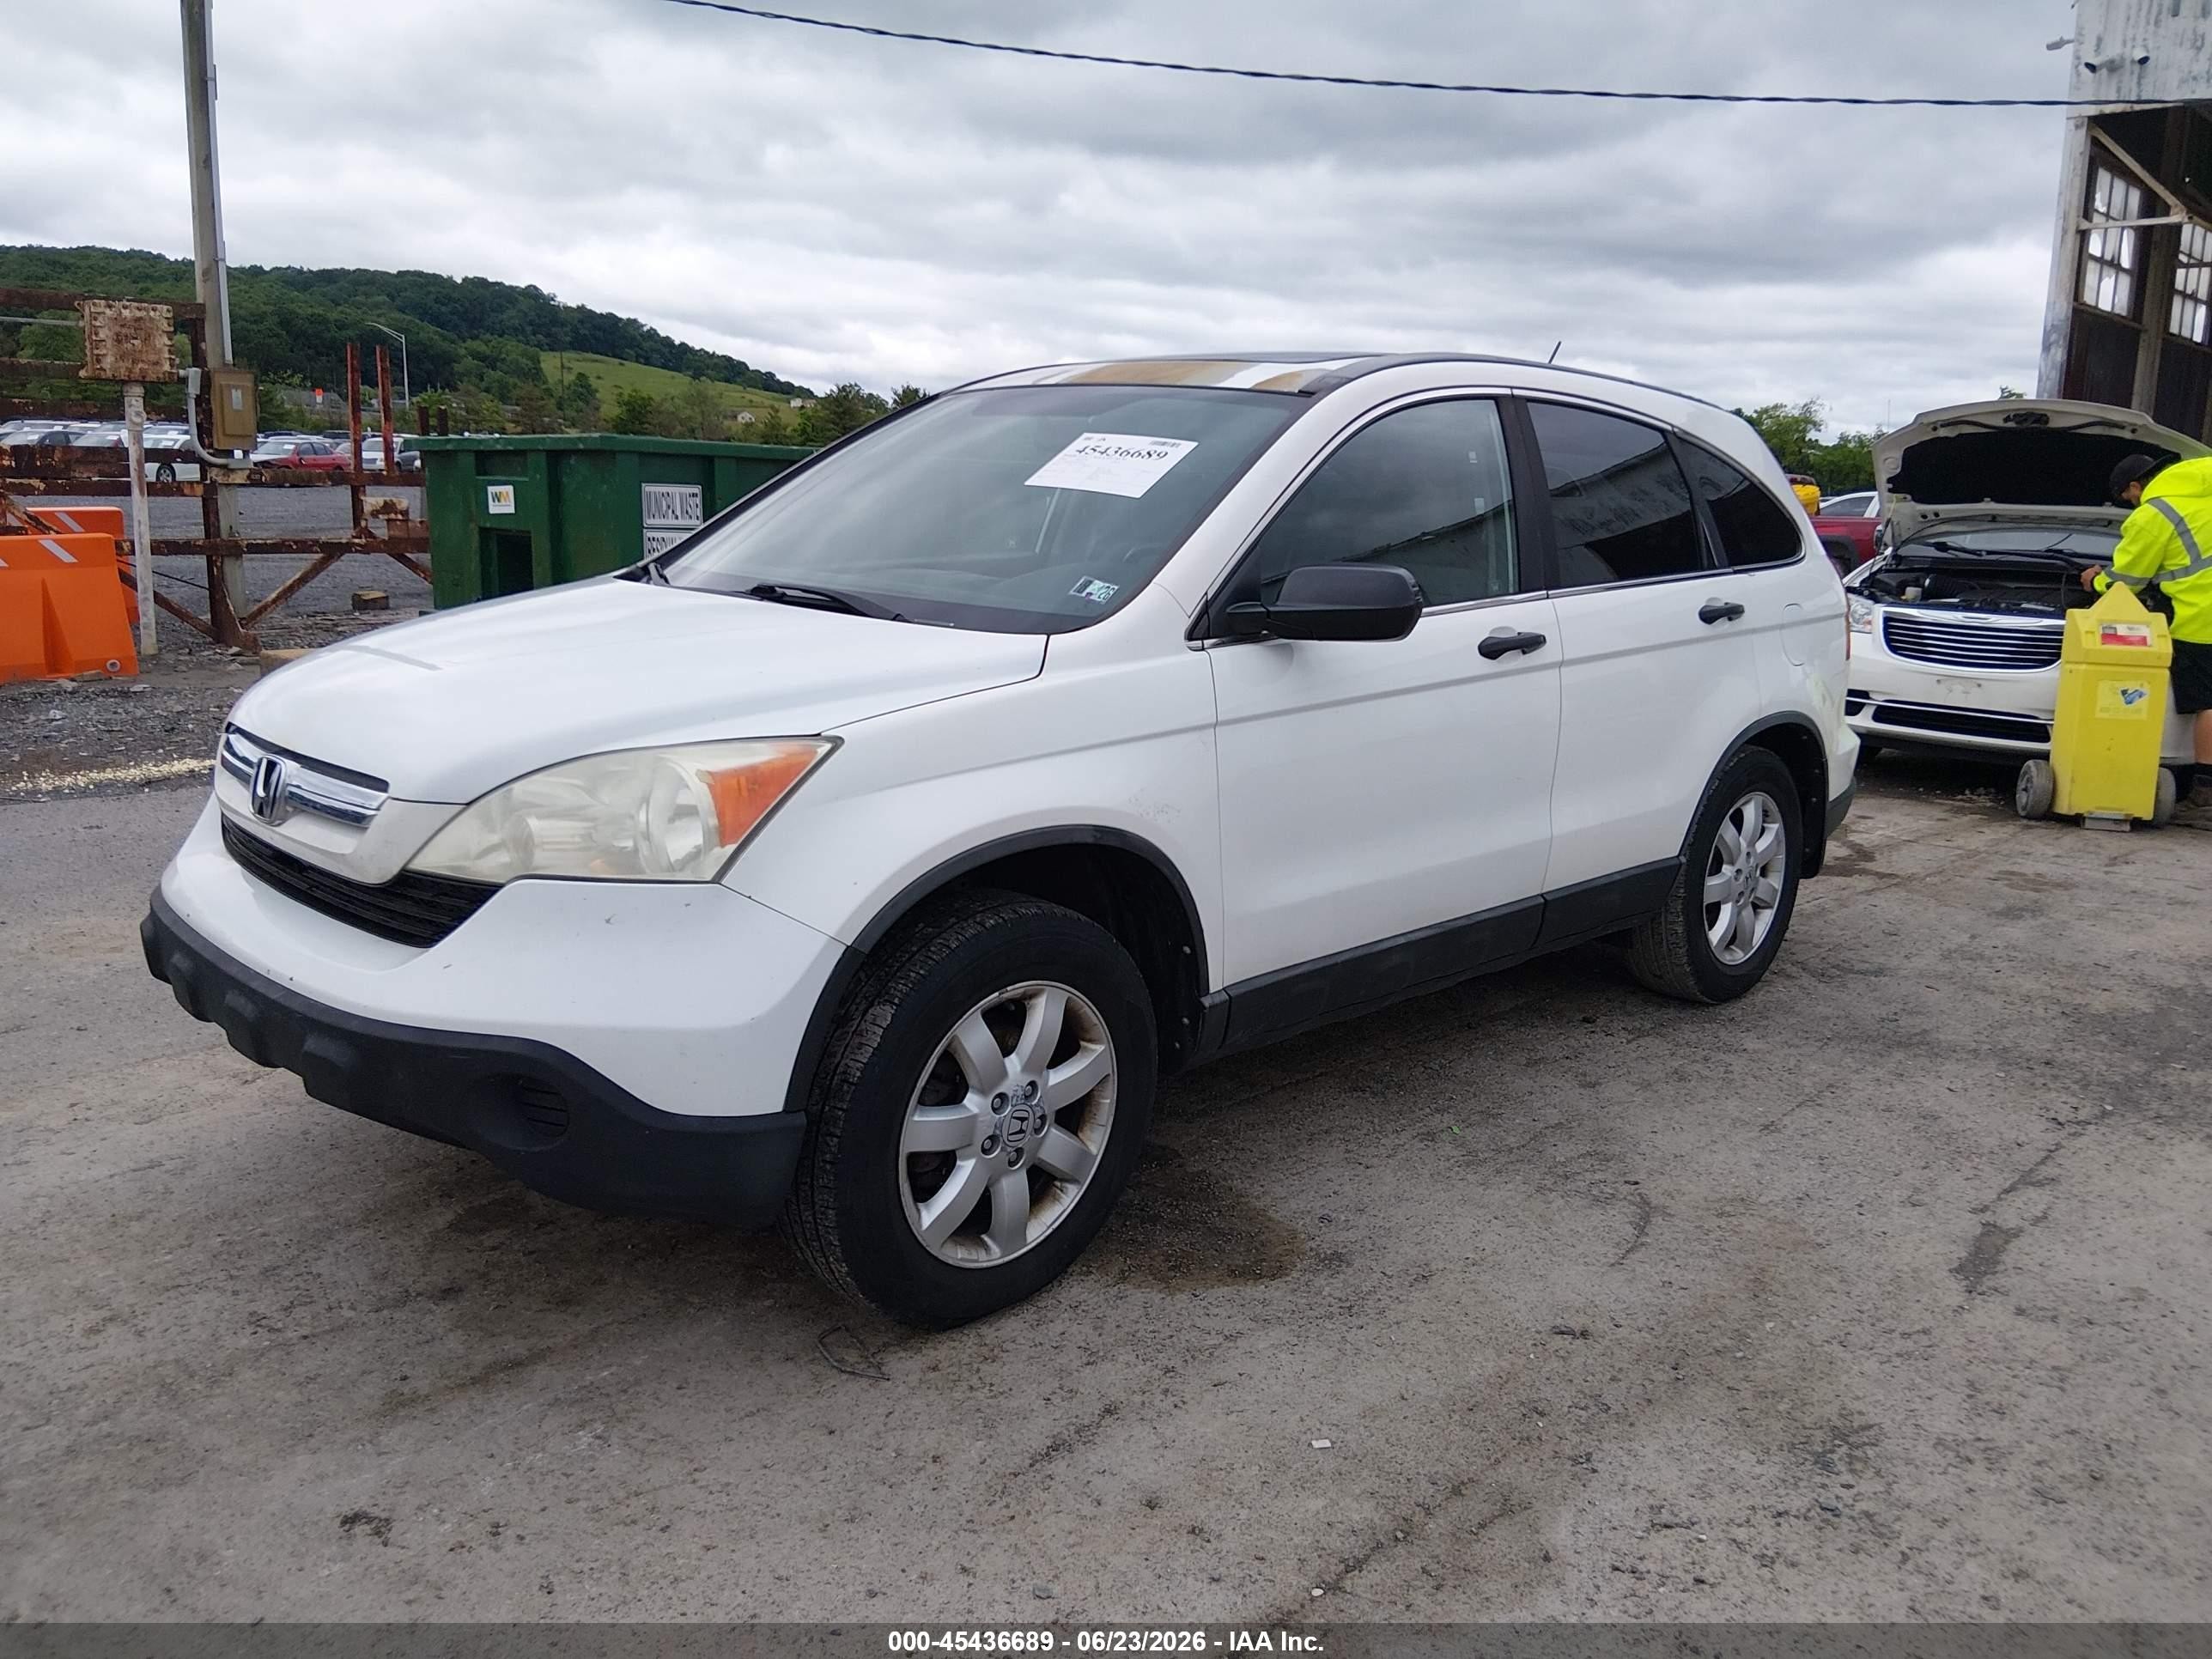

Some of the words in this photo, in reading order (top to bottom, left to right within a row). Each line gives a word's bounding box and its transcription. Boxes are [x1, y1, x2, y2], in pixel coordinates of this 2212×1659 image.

[1076, 444, 1169, 461] 45436689
[490, 490, 510, 503] WM
[679, 492, 699, 520] WASTE
